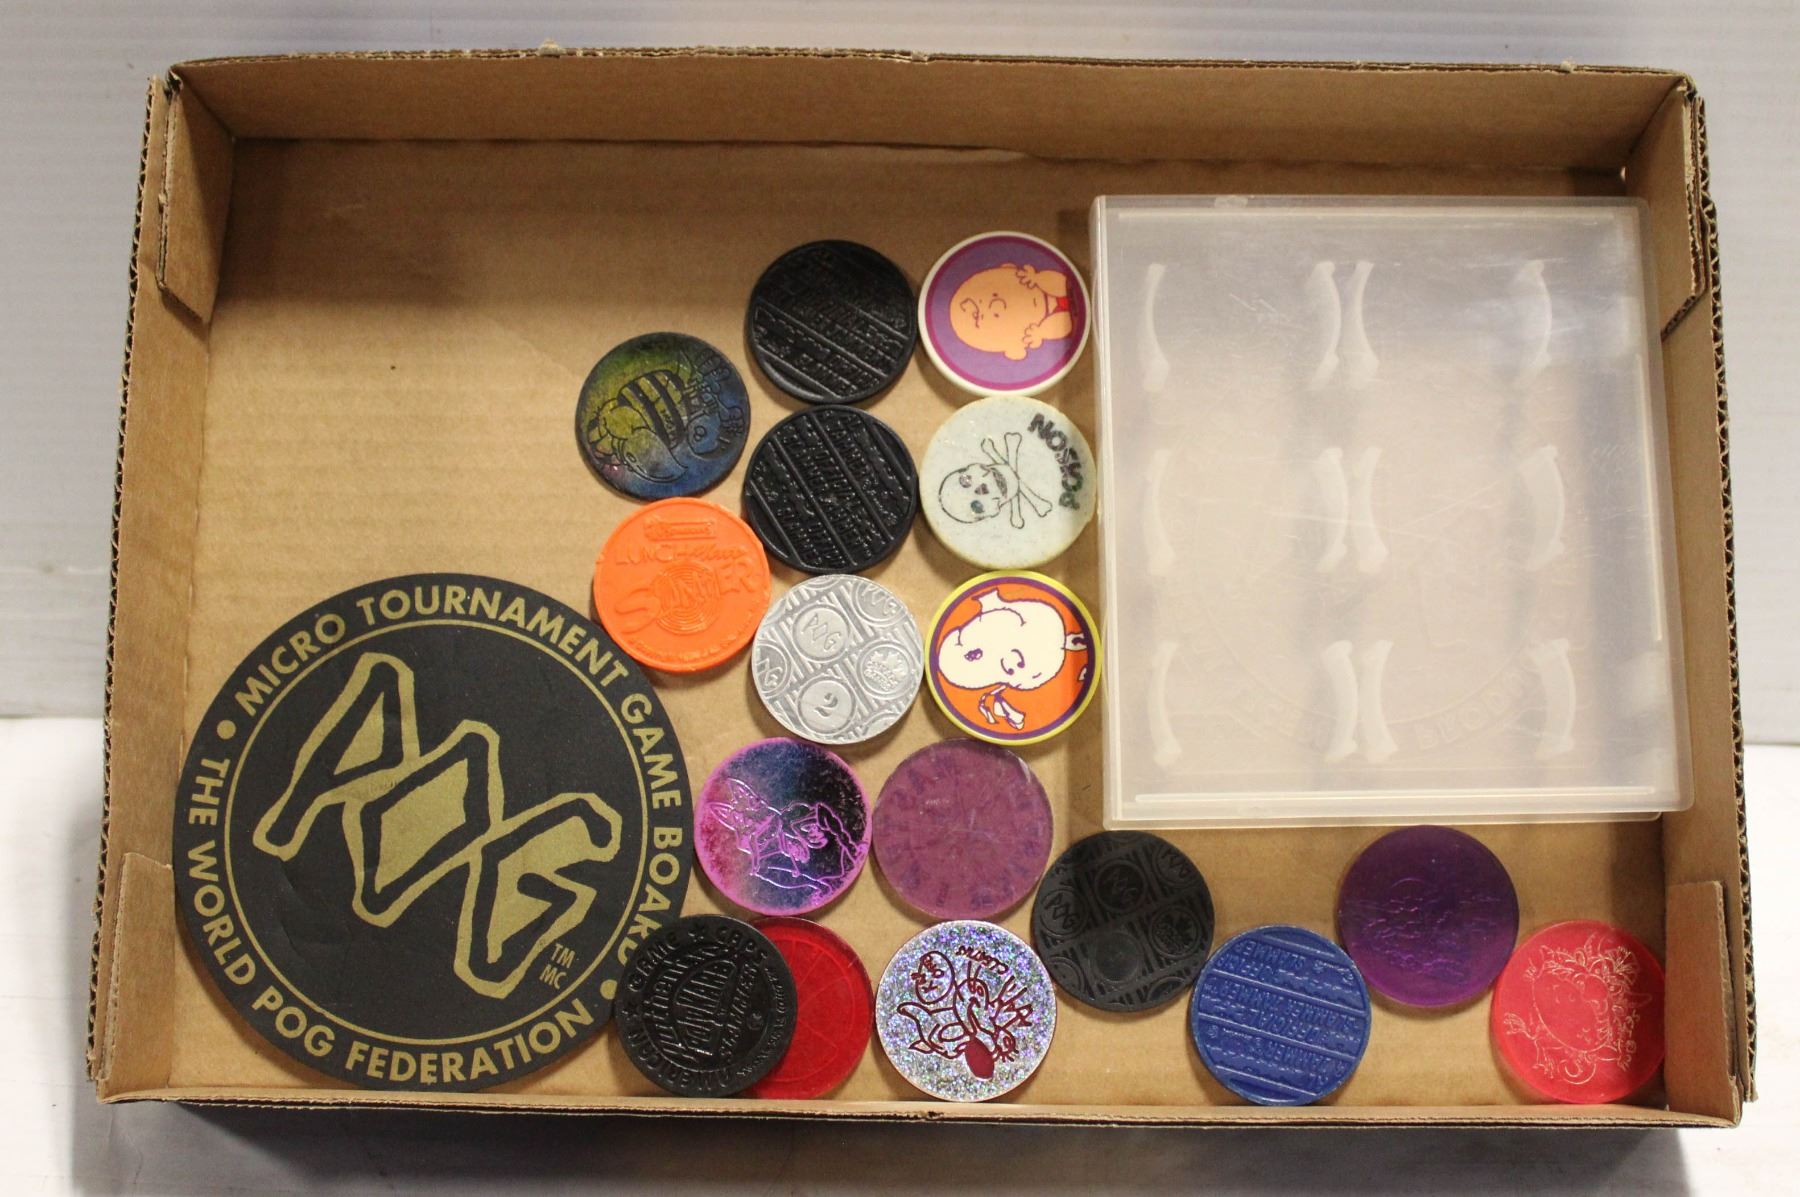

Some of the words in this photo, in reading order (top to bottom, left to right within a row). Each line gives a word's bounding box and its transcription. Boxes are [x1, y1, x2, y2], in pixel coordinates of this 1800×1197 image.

[1028, 413, 1083, 510] POISON
[234, 613, 346, 717] MICRO
[357, 584, 628, 687] TOURNAMENT
[621, 693, 682, 808] GAME
[189, 758, 230, 825] THE
[189, 845, 256, 984] WORLD
[539, 965, 567, 988] MC
[550, 942, 576, 968] TM
[252, 987, 334, 1057] POG
[346, 999, 595, 1085] FEDERATION
